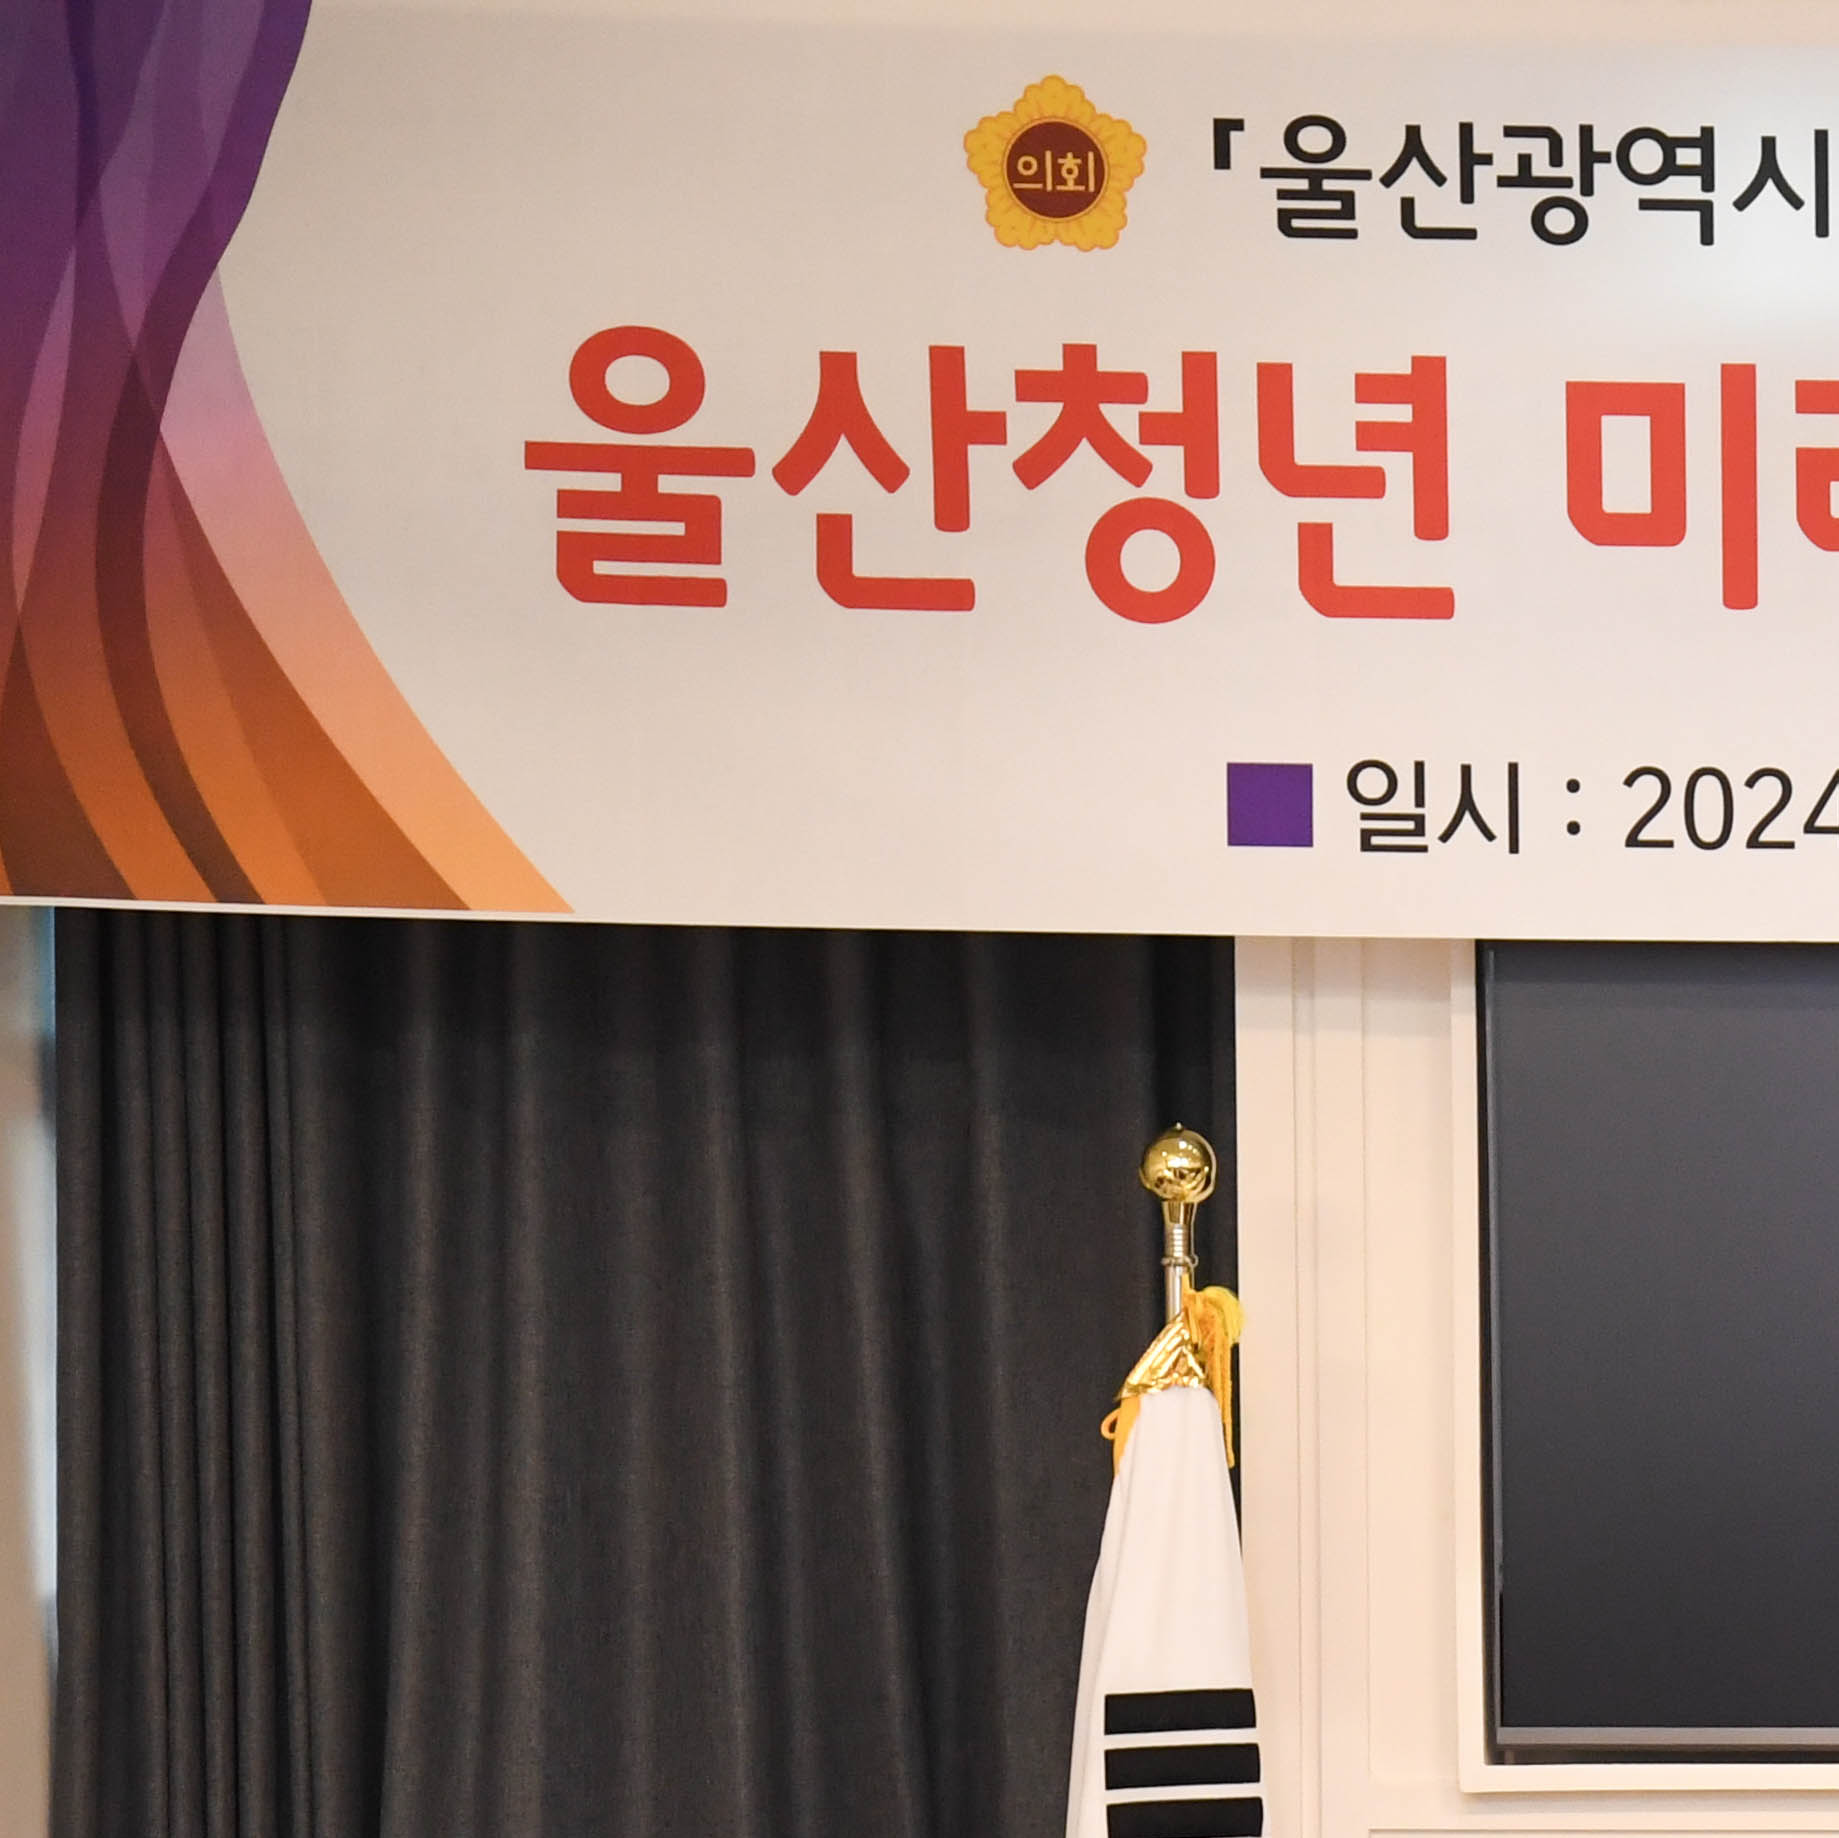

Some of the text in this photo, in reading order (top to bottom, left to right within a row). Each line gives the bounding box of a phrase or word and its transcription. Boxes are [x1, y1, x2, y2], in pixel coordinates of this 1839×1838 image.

[1013, 149, 1096, 193] 의회
[524, 325, 1455, 625] 울산청년
[1346, 759, 1520, 855] 일시
